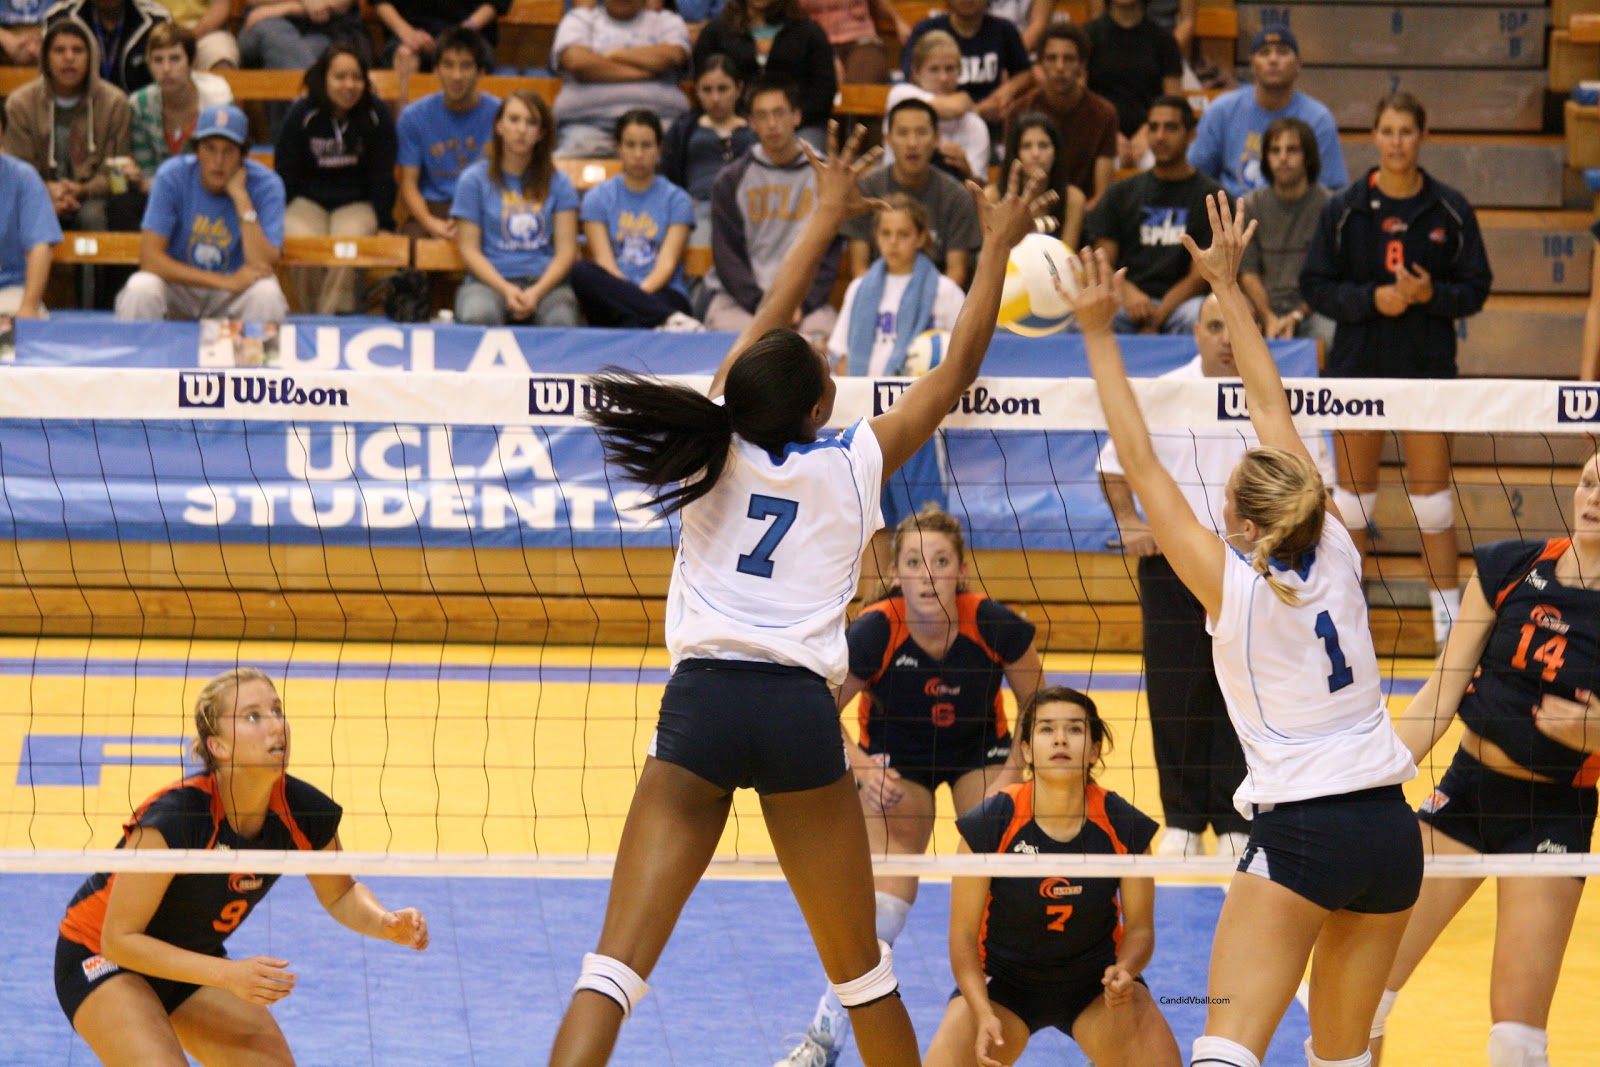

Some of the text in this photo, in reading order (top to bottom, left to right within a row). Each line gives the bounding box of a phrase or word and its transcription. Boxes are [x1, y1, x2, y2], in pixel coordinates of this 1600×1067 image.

[747, 184, 817, 224] UCLA
[1385, 239, 1404, 272] 8
[278, 327, 533, 372] UCLA
[231, 376, 348, 407] Wilson
[950, 386, 1041, 416] ilson
[285, 425, 556, 481] UCLA
[182, 484, 664, 531] STUDENTS
[736, 494, 799, 579] 7
[1314, 609, 1355, 694] 1
[1510, 623, 1569, 684] 14
[212, 899, 249, 933] 9
[1045, 904, 1074, 933] 7
